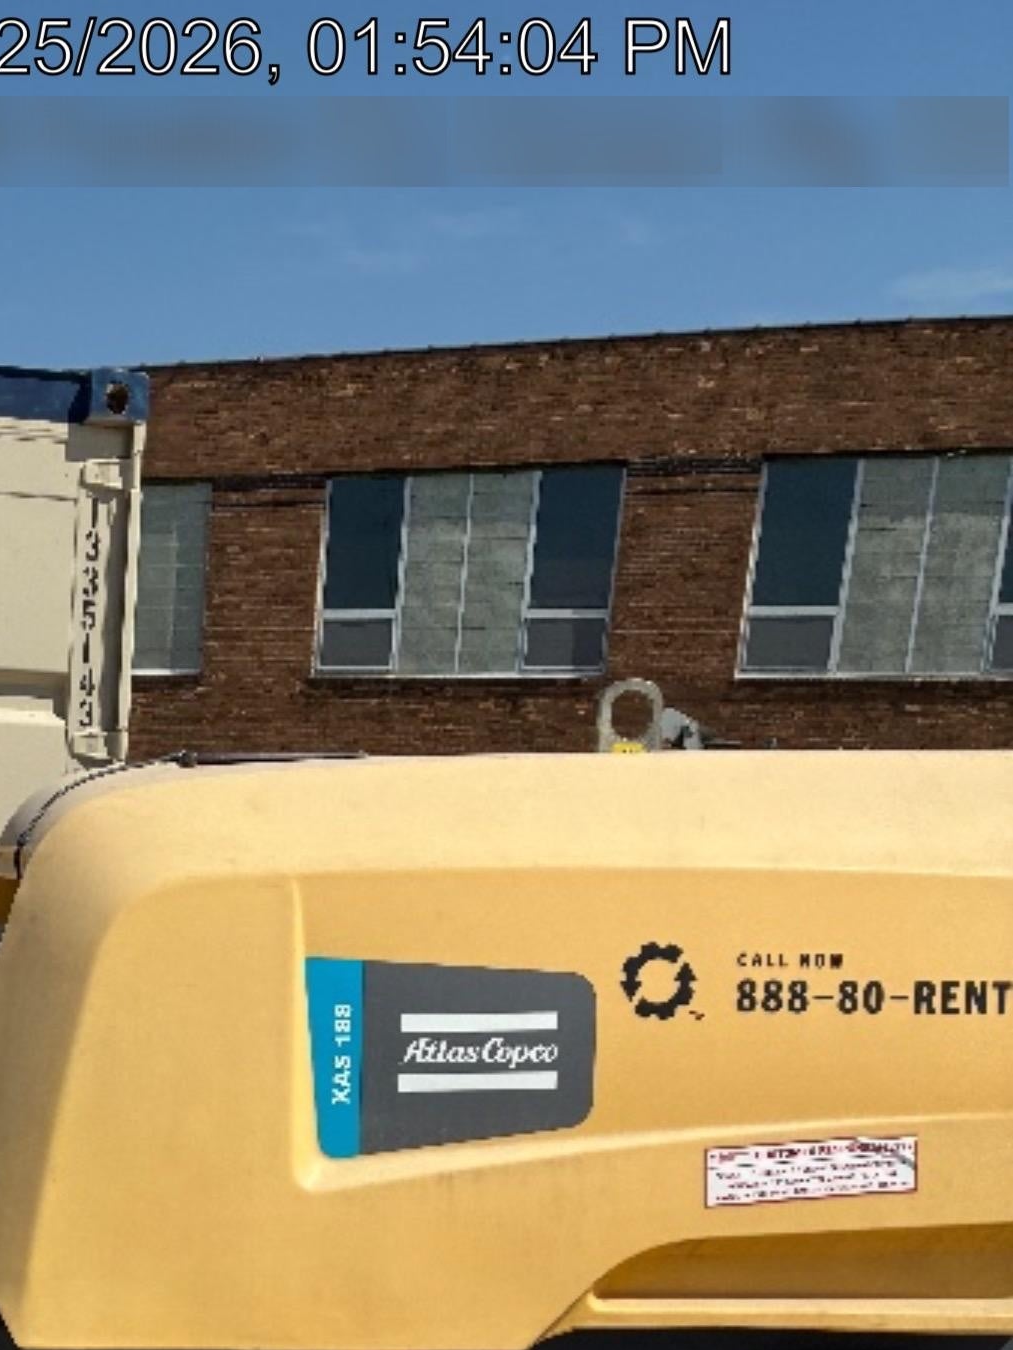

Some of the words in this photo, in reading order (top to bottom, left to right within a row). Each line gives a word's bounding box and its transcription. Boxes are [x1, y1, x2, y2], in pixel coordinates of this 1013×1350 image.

[736, 953, 789, 968] CALL
[799, 953, 844, 969] NOW
[736, 979, 1013, 1015] 888-80-RENT
[401, 1037, 480, 1064] Atlas
[481, 1037, 558, 1069] Copco
